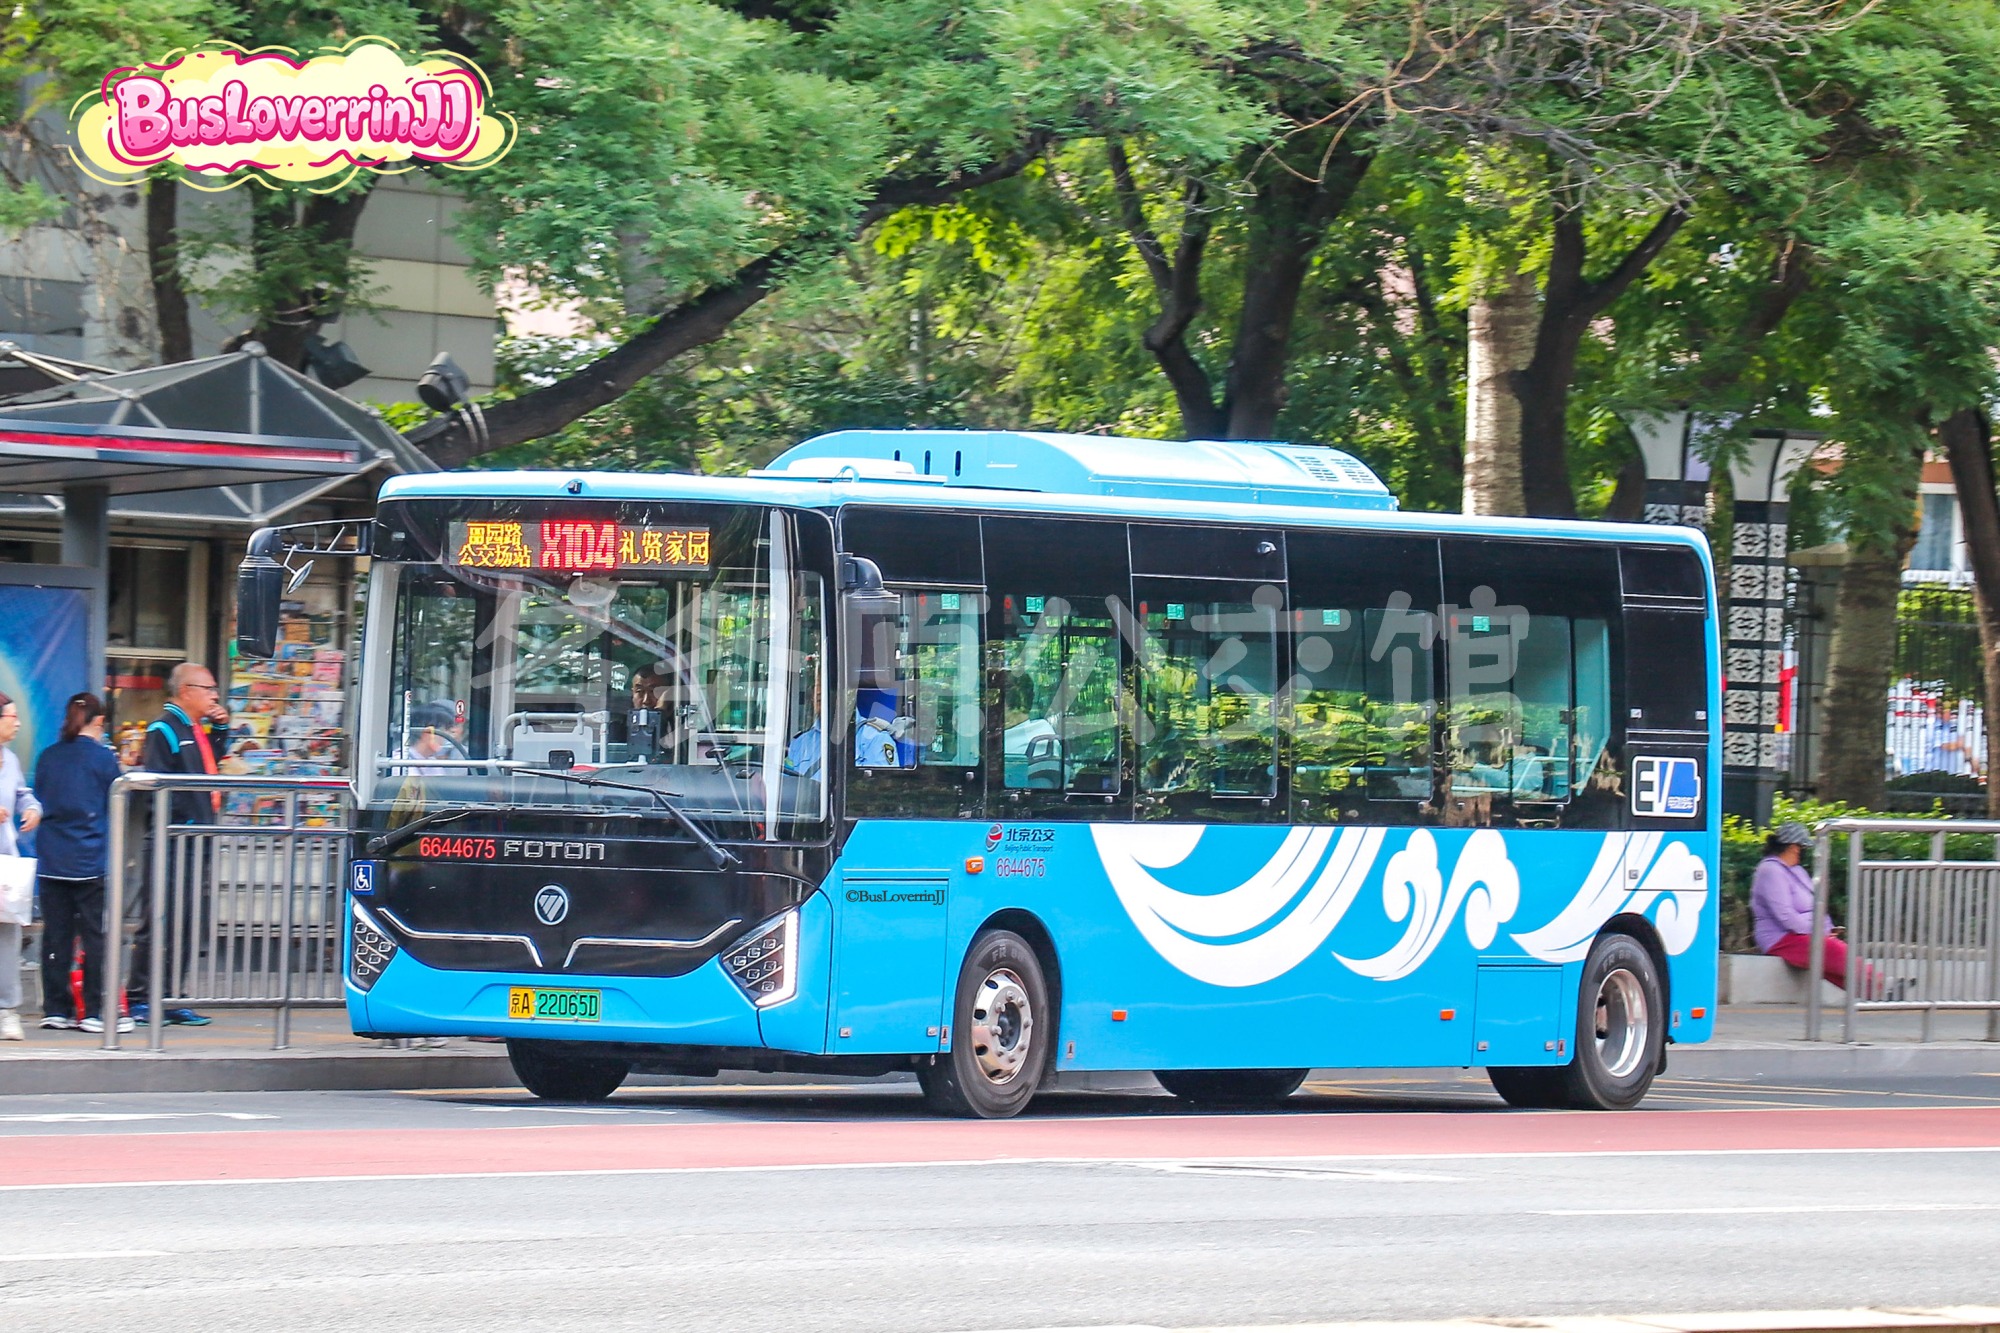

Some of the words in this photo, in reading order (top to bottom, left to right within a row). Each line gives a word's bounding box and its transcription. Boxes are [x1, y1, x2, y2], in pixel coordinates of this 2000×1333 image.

[466, 522, 523, 546] 丽园路
[540, 521, 617, 569] X104
[459, 544, 532, 568] 公交场站
[618, 530, 710, 566] 礼贤家园
[1006, 828, 1055, 841] 北京公交
[420, 837, 496, 858] 6644675
[503, 839, 605, 861] FOTON
[997, 857, 1045, 877] 6644675
[511, 992, 530, 1015] 京A
[538, 993, 598, 1017] 22065D
